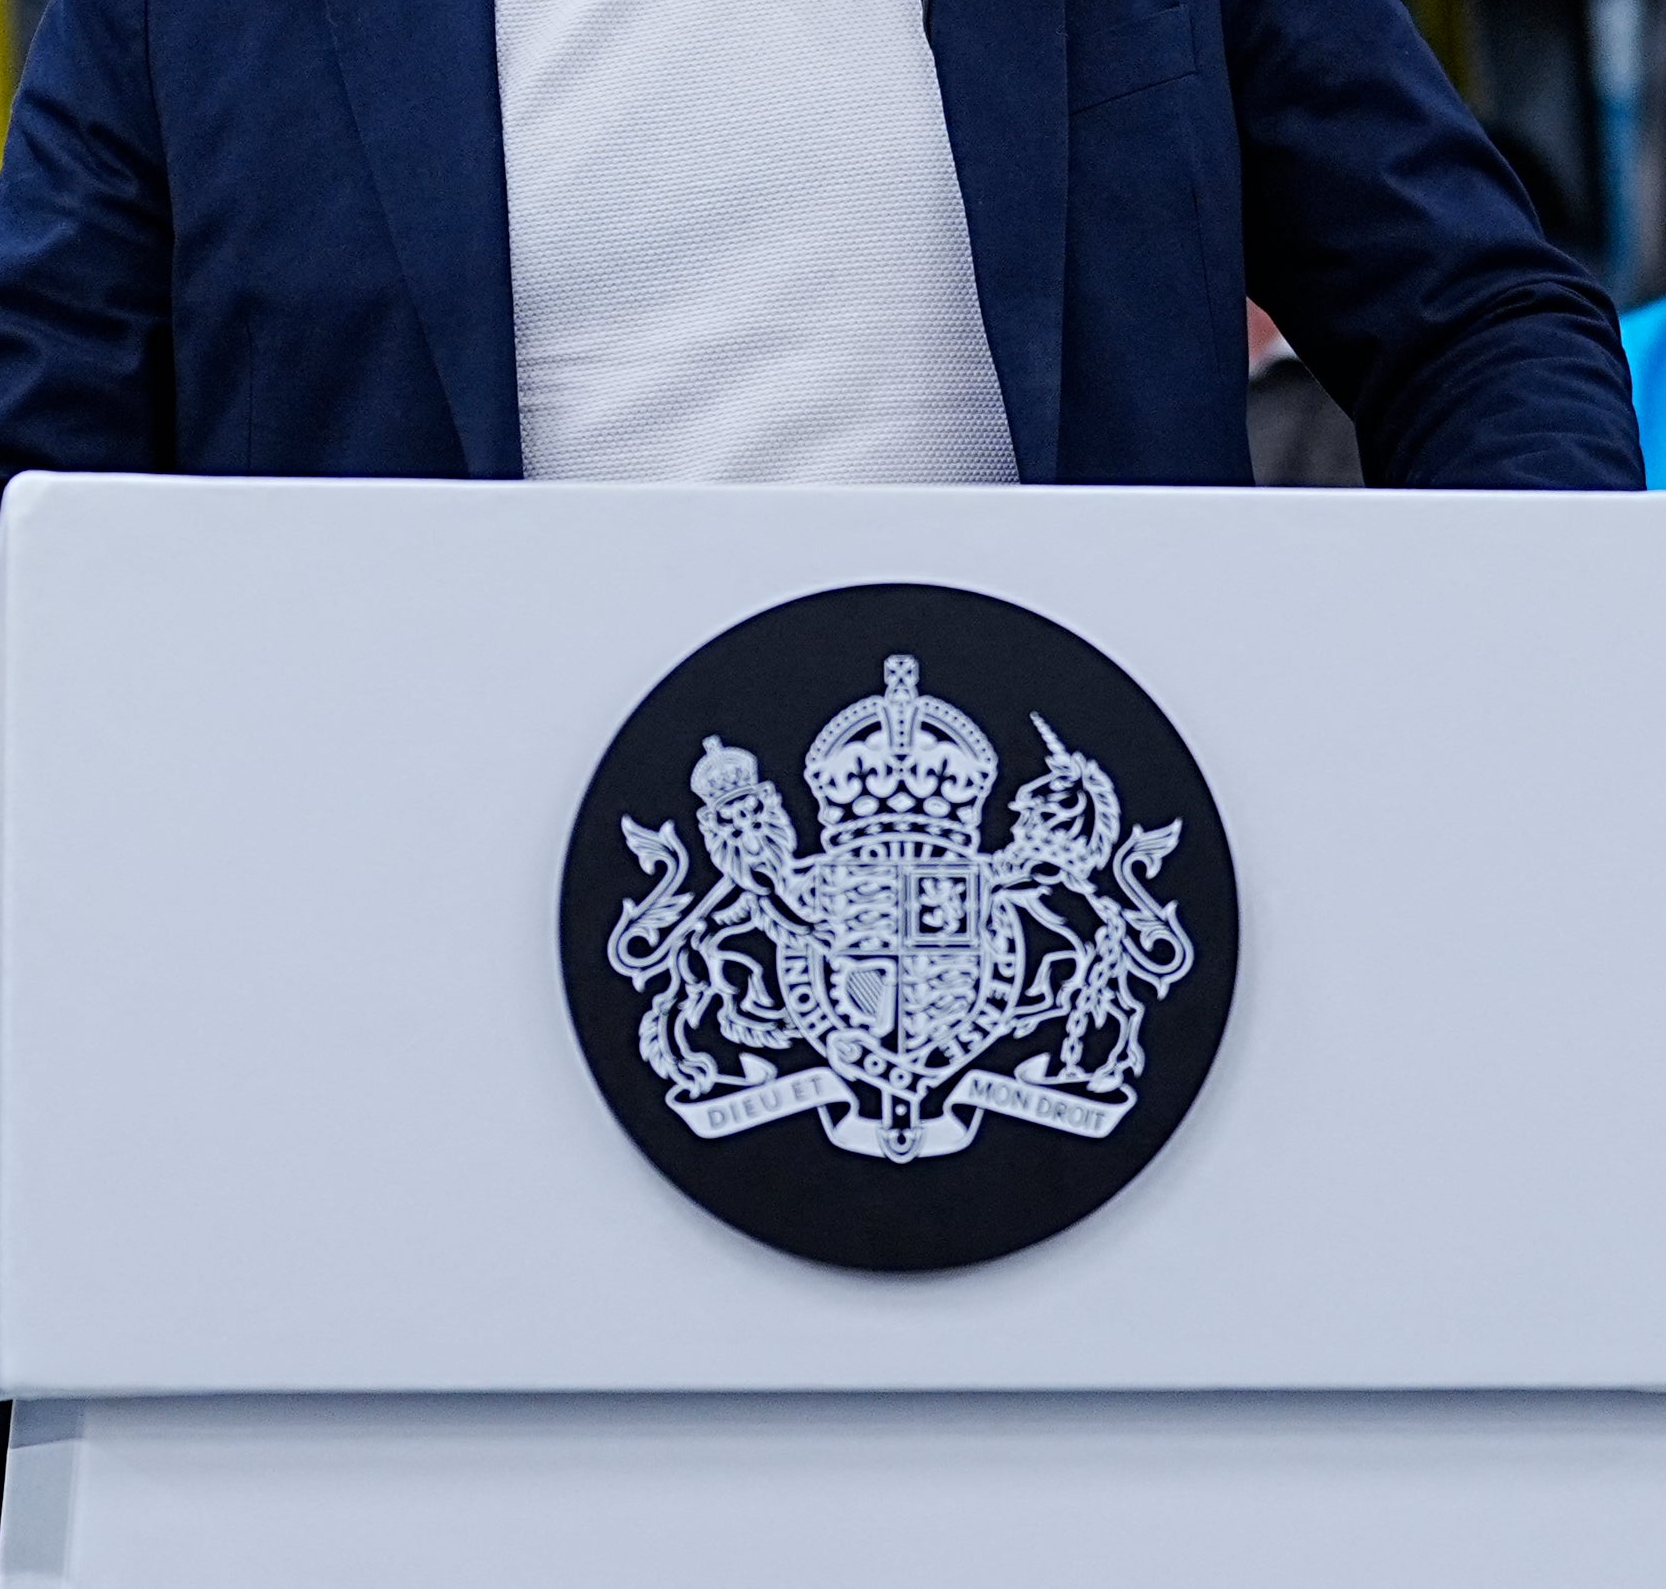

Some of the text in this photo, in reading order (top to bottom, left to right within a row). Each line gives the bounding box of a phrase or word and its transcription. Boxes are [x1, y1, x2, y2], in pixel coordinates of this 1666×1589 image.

[707, 1076, 823, 1130] DIEU ET
[969, 1078, 1106, 1131] MON DROIT
